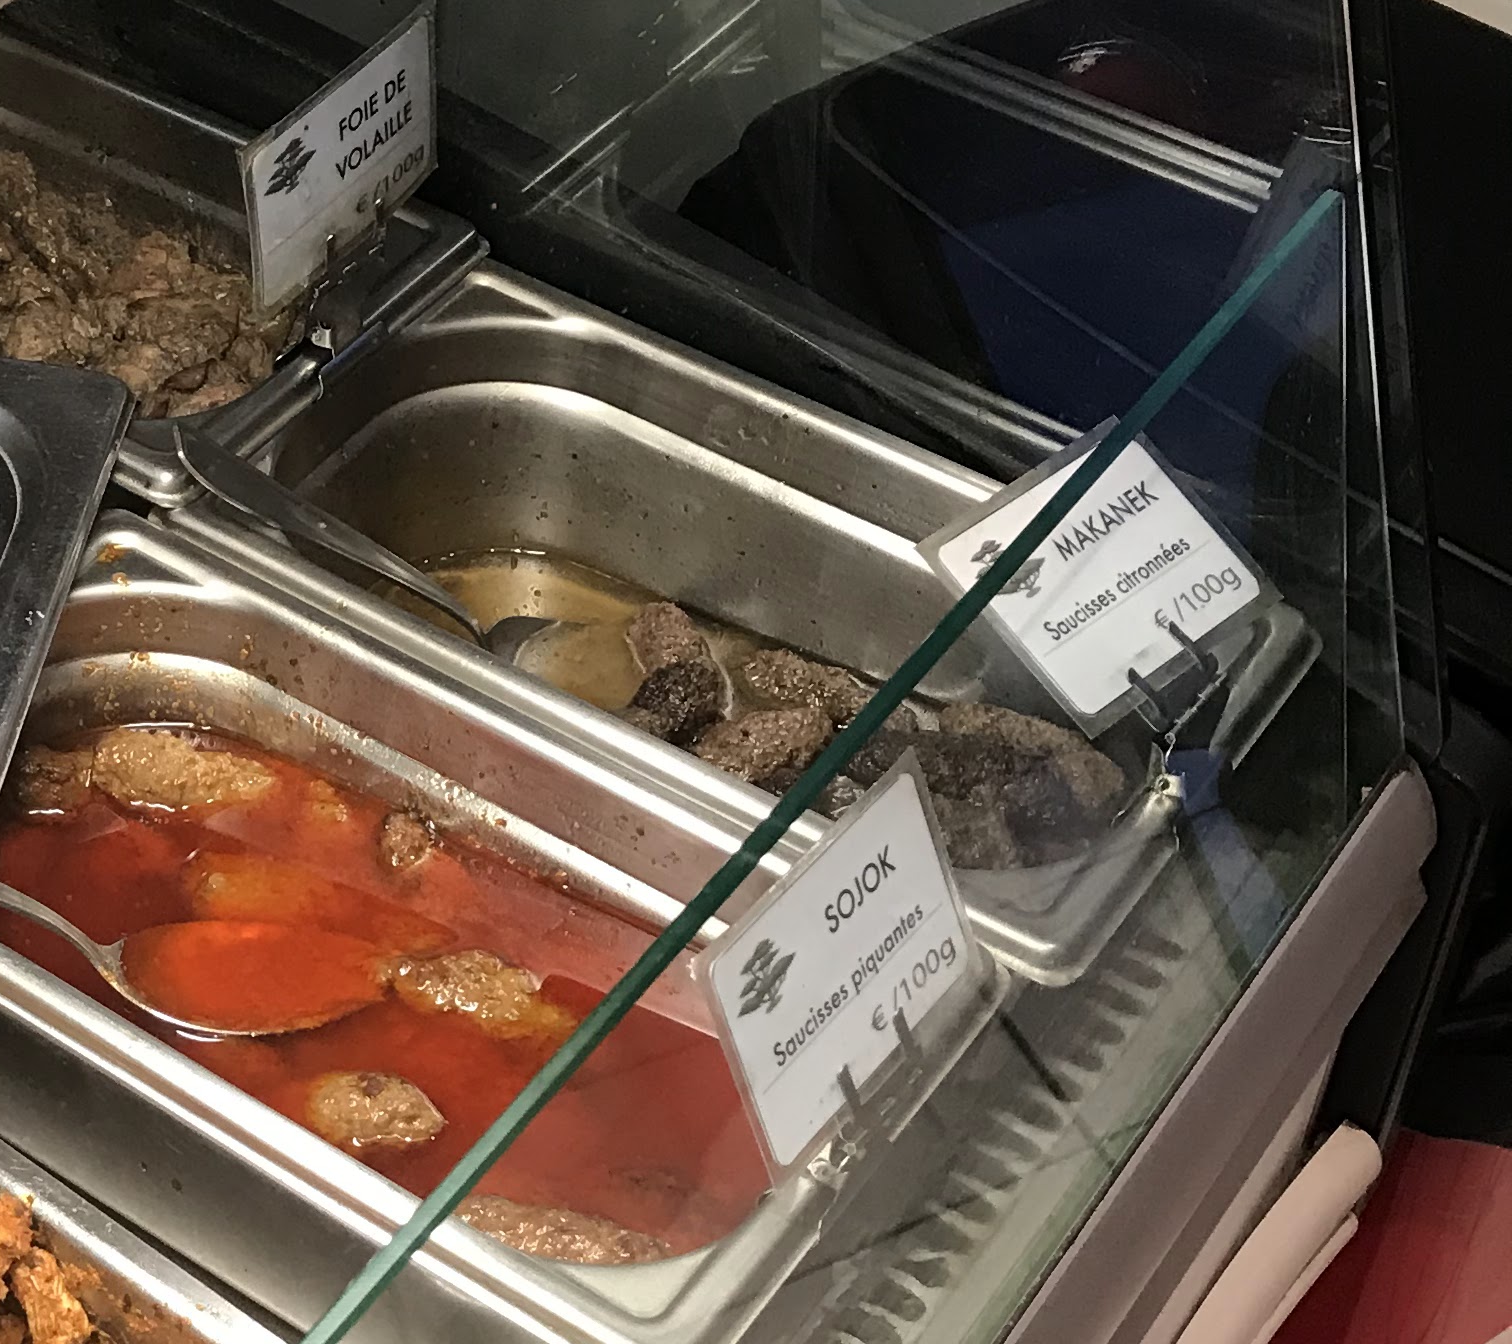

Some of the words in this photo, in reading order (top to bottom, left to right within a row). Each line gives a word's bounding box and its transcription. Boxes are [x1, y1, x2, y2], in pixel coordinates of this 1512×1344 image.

[335, 100, 413, 181] VOLAILLE
[337, 90, 379, 142] FOIE
[384, 69, 407, 106] DE
[1051, 479, 1161, 563] MAKANEK
[1043, 586, 1118, 642] Saucisses
[1116, 536, 1192, 600] citronnées
[824, 844, 898, 934] SOJOK
[772, 985, 850, 1067] Saucisses
[851, 902, 925, 996] piquantes
